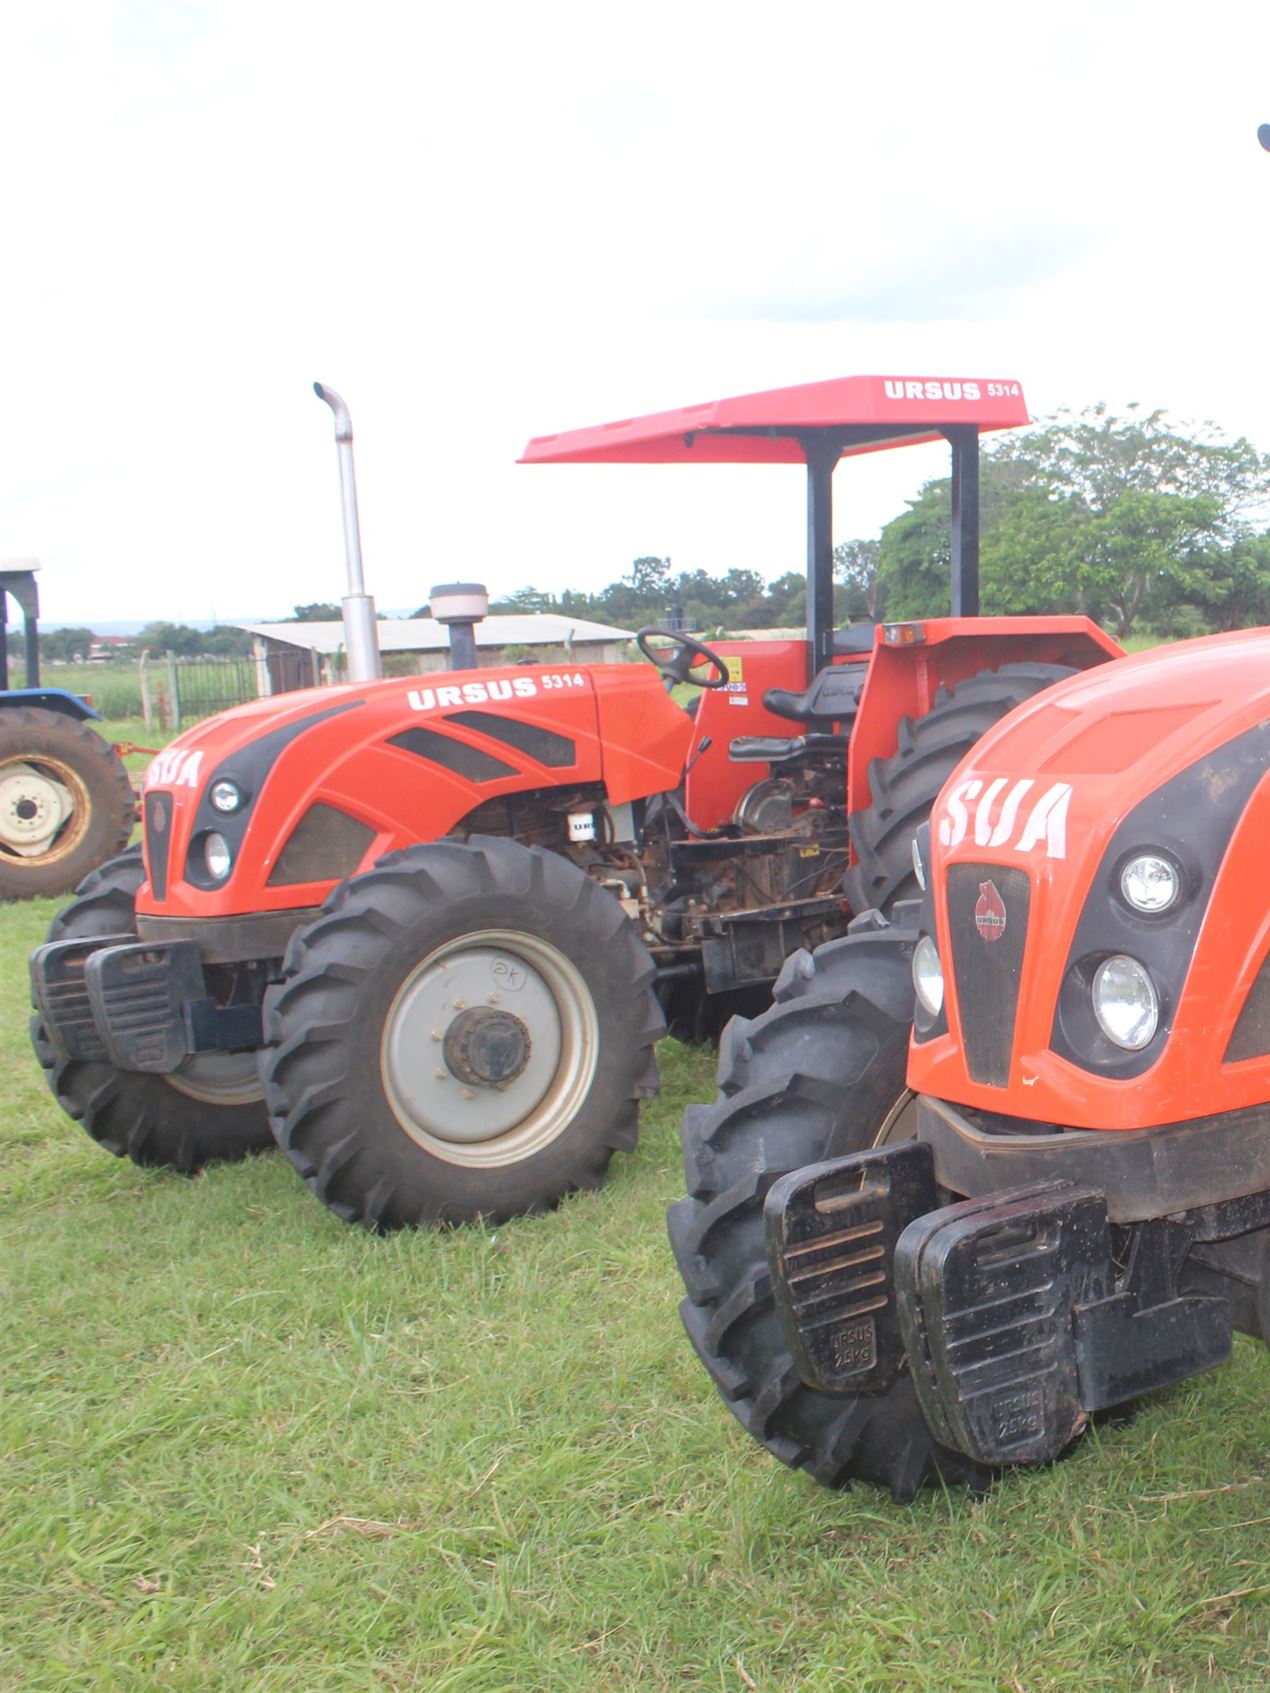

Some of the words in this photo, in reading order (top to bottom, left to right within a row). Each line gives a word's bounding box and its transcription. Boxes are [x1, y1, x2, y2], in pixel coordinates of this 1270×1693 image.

[884, 380, 981, 400] URSUS
[987, 383, 1019, 397] 5314
[407, 677, 537, 711] URSUS
[541, 673, 584, 689] 5314
[939, 778, 1073, 859] SUA
